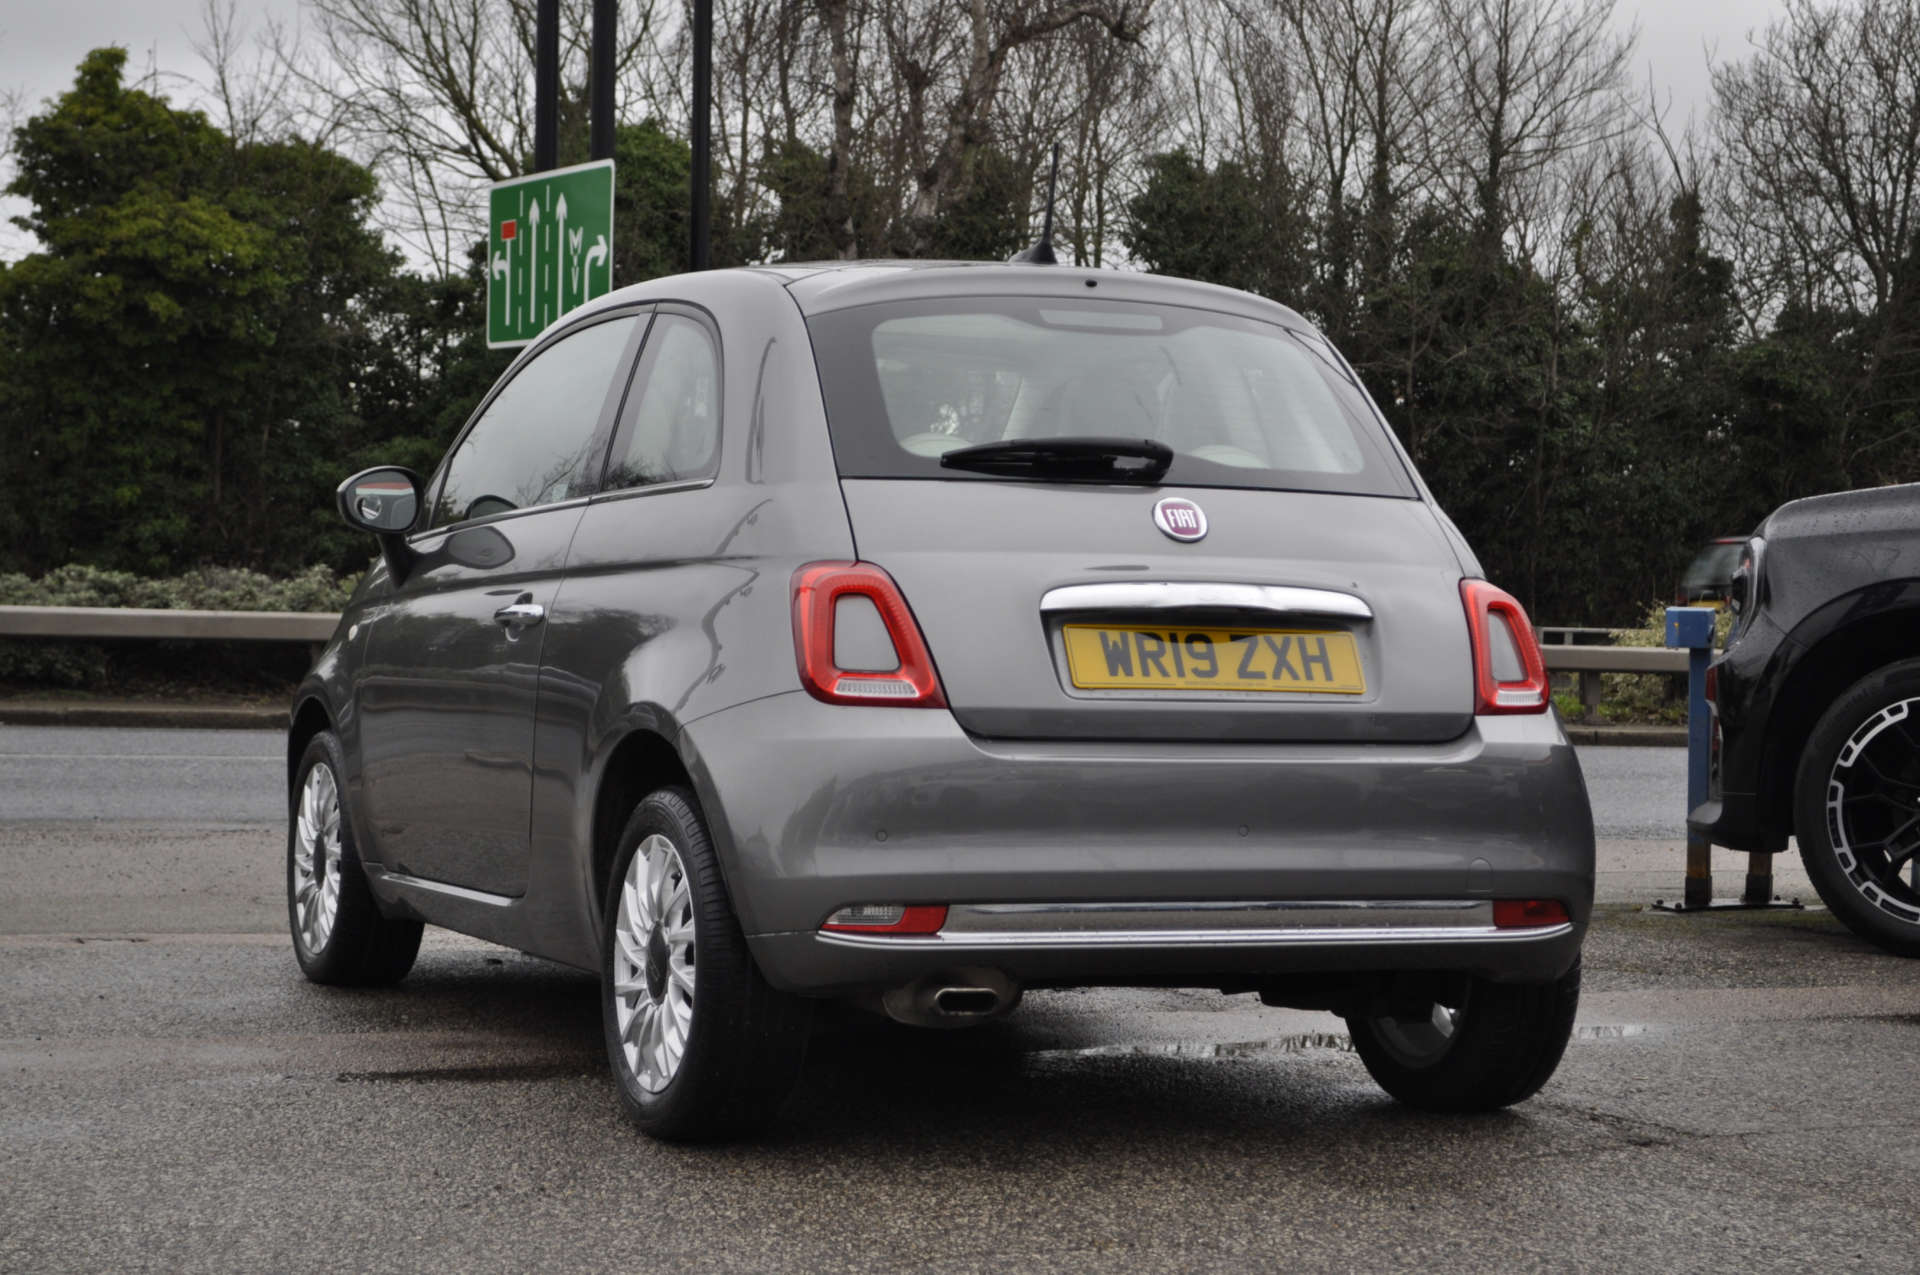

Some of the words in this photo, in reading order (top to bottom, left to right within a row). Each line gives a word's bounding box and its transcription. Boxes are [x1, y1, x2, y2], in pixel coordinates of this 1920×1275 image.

[1166, 508, 1197, 528] FIAT
[1100, 631, 1219, 678] WR19
[1230, 634, 1334, 682] ZXH
